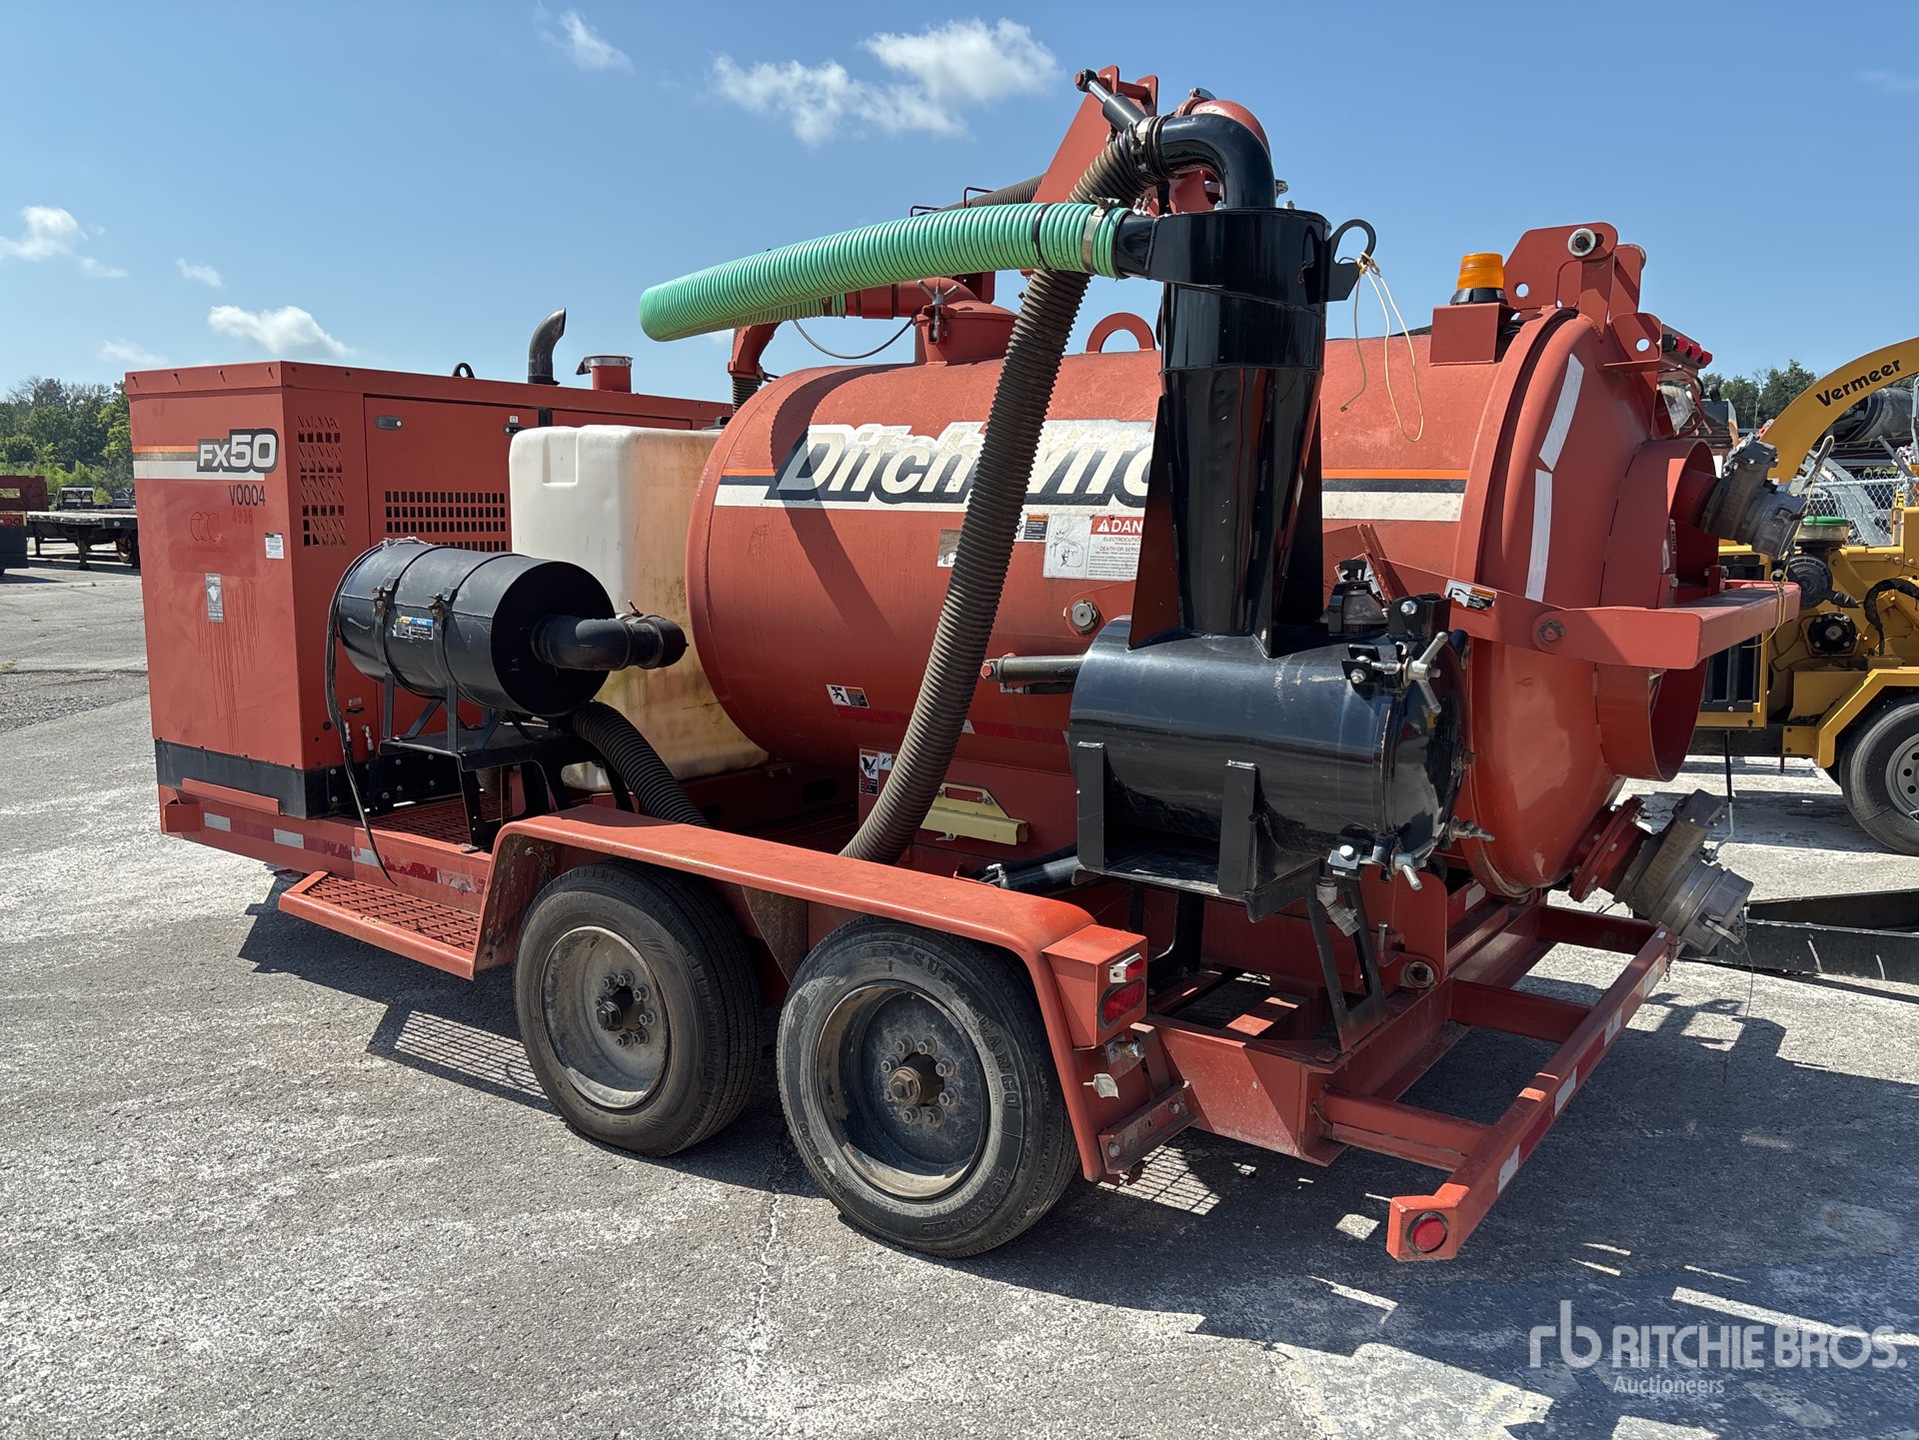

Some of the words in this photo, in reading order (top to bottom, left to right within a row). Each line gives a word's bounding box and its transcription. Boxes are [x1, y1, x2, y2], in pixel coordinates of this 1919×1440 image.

[1815, 360, 1901, 407] Vermeer
[199, 433, 277, 468] FX50
[776, 429, 983, 494] Ditch
[229, 485, 266, 507] V0004
